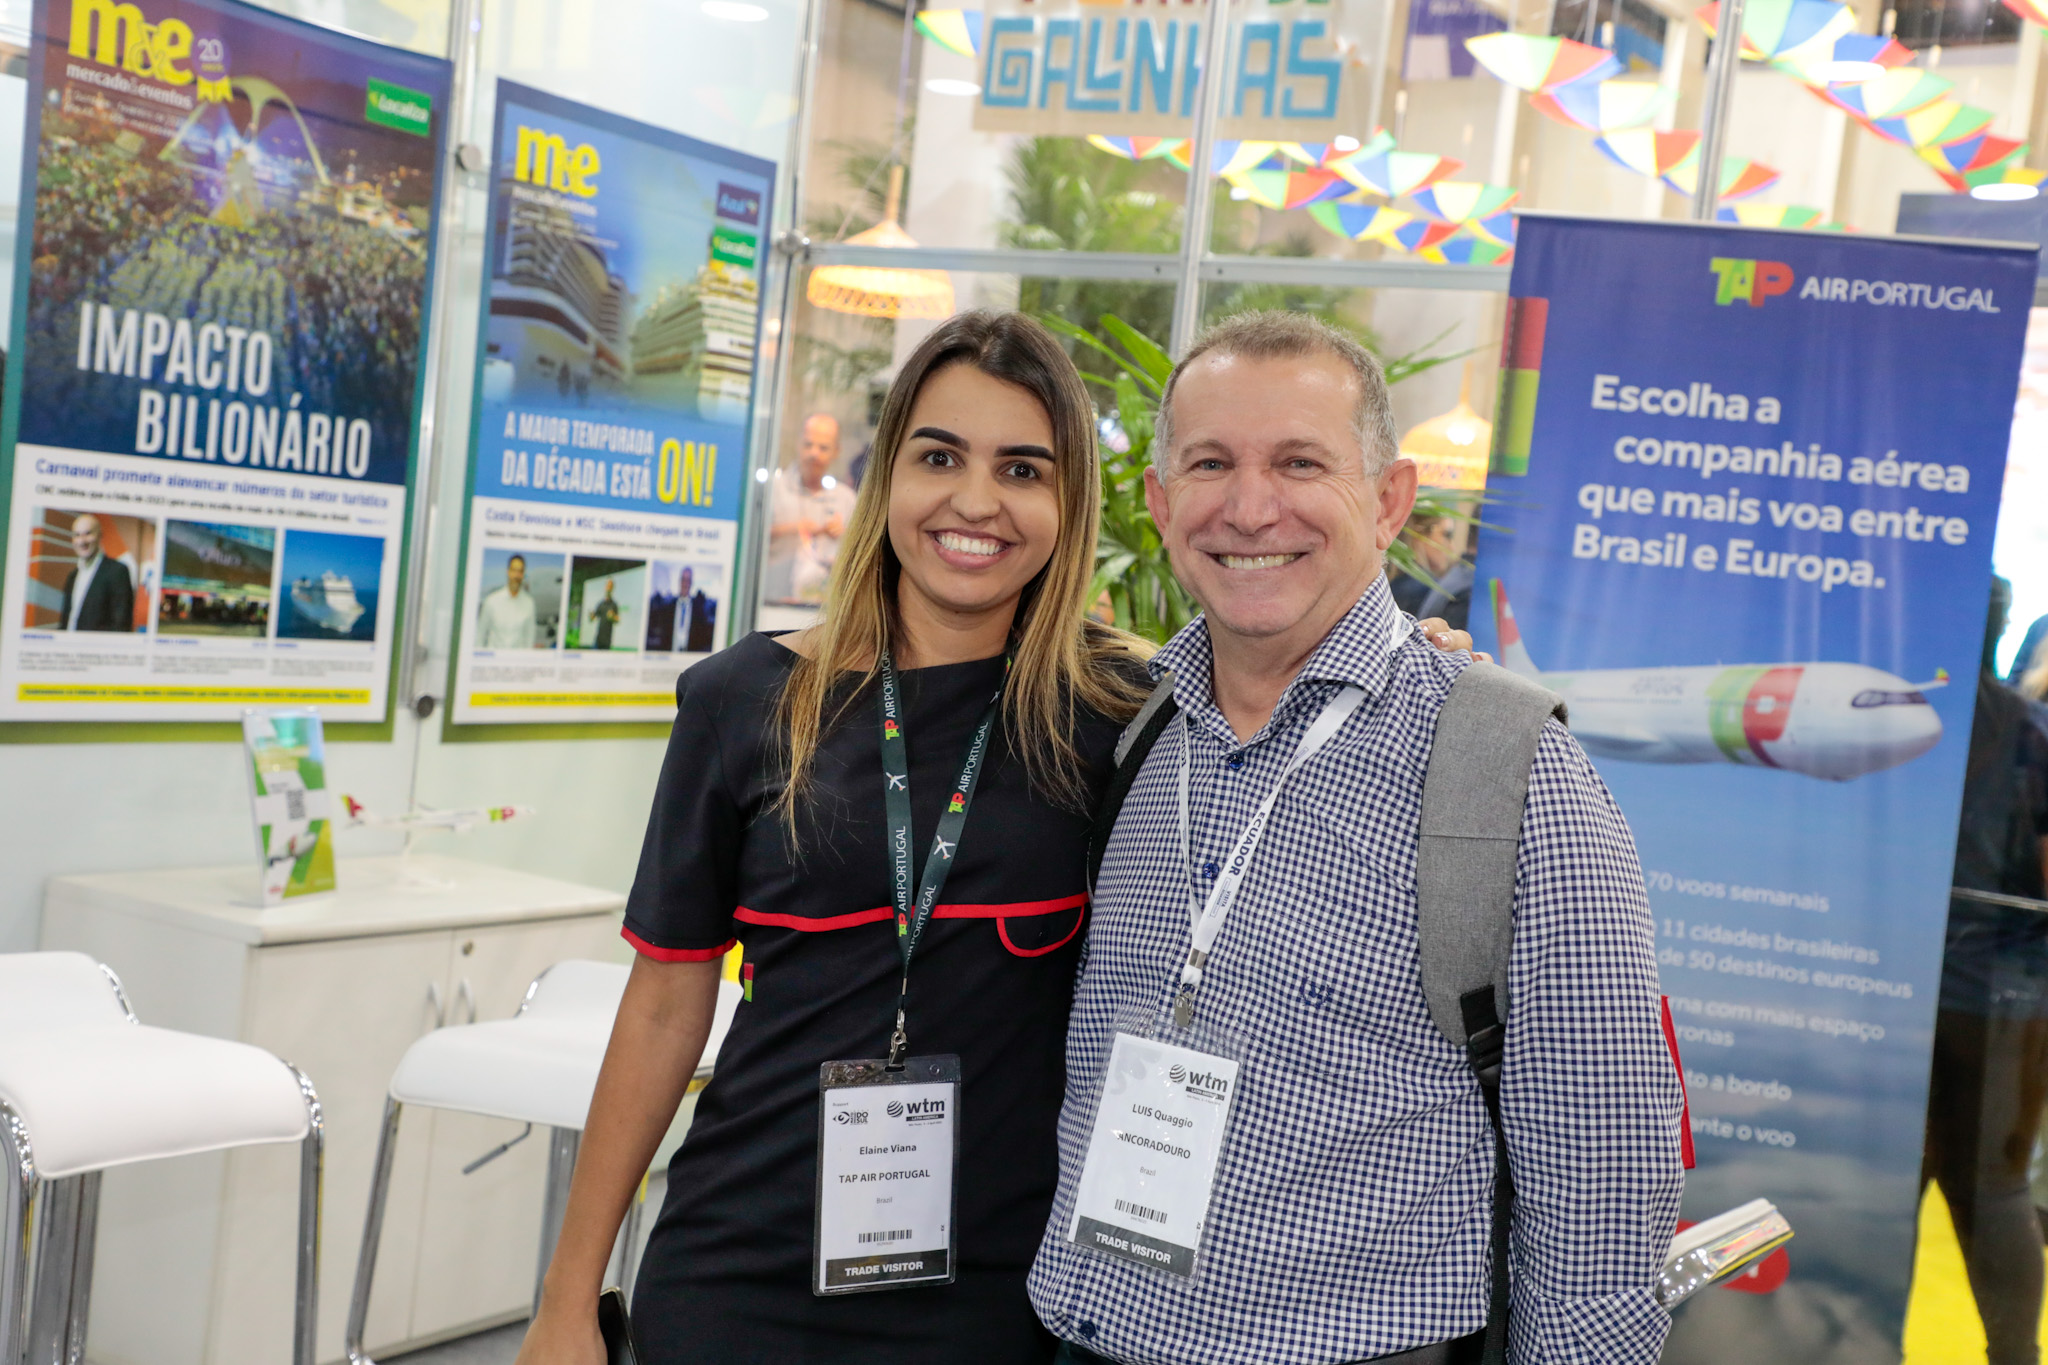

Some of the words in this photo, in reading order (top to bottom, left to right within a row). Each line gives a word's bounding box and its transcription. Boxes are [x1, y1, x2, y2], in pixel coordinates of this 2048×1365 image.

[1710, 257, 1795, 308] TAP
[77, 301, 273, 397] IMPACTO
[1591, 374, 1749, 422] Escolha
[1754, 396, 1781, 424] a
[136, 388, 371, 478] BILIONÁRIO
[504, 411, 516, 438] A
[519, 412, 570, 445] MAIOR
[572, 419, 655, 456] TEMPORADA
[35, 458, 98, 480] Carnaval
[501, 449, 529, 487] DA
[532, 445, 606, 495] DÉCADA
[610, 457, 651, 499] ESTÁ
[657, 437, 718, 507] ON!
[1614, 433, 1843, 482] companhia
[1848, 451, 1970, 494] aérea
[1577, 482, 1655, 523] que
[1661, 485, 1761, 525] mais
[1768, 499, 1843, 533] voa
[1849, 506, 1969, 546] entre
[1572, 524, 1686, 568] Brasil
[1692, 543, 1718, 572] e
[1725, 539, 1886, 593] Europa.
[884, 719, 899, 740] TAP
[948, 792, 965, 813] TAP
[1228, 812, 1265, 876] ECUADOR
[1674, 877, 1726, 899] voos
[1730, 884, 1830, 913] semanais
[898, 912, 908, 938] TAP
[1663, 918, 1686, 939] 11
[1689, 922, 1771, 950] cidades
[1773, 932, 1880, 965] brasileiras
[1657, 947, 1685, 967] de
[1687, 950, 1716, 971] 50
[1717, 952, 1809, 984] destinos
[1811, 969, 1914, 1000] europeus
[1676, 1025, 1735, 1047] ronas
[1704, 1001, 1751, 1021] com
[1754, 1007, 1805, 1029] mais
[1808, 1015, 1886, 1043] espaço
[1189, 1071, 1229, 1093] wtm
[1685, 1068, 1709, 1089] to
[1709, 1074, 1725, 1092] a
[1726, 1072, 1792, 1101] bordo
[907, 1098, 945, 1114] wtm
[1132, 1104, 1152, 1117] LUIS
[1155, 1110, 1193, 1128] Quaggio
[1690, 1116, 1735, 1139] ante
[1735, 1124, 1752, 1141] o
[1753, 1126, 1796, 1147] voo
[859, 1145, 889, 1155] Elaine
[890, 1144, 917, 1153] Viana
[839, 1174, 858, 1184] TAP
[861, 1172, 877, 1183] AIR
[878, 1168, 931, 1182] PORTUGAL
[1140, 1166, 1156, 1177] Brazil
[1095, 1232, 1129, 1251] TRADE
[1131, 1243, 1172, 1264] VISITOR
[845, 1265, 880, 1277] TRADE
[882, 1261, 924, 1273] VISITOR
